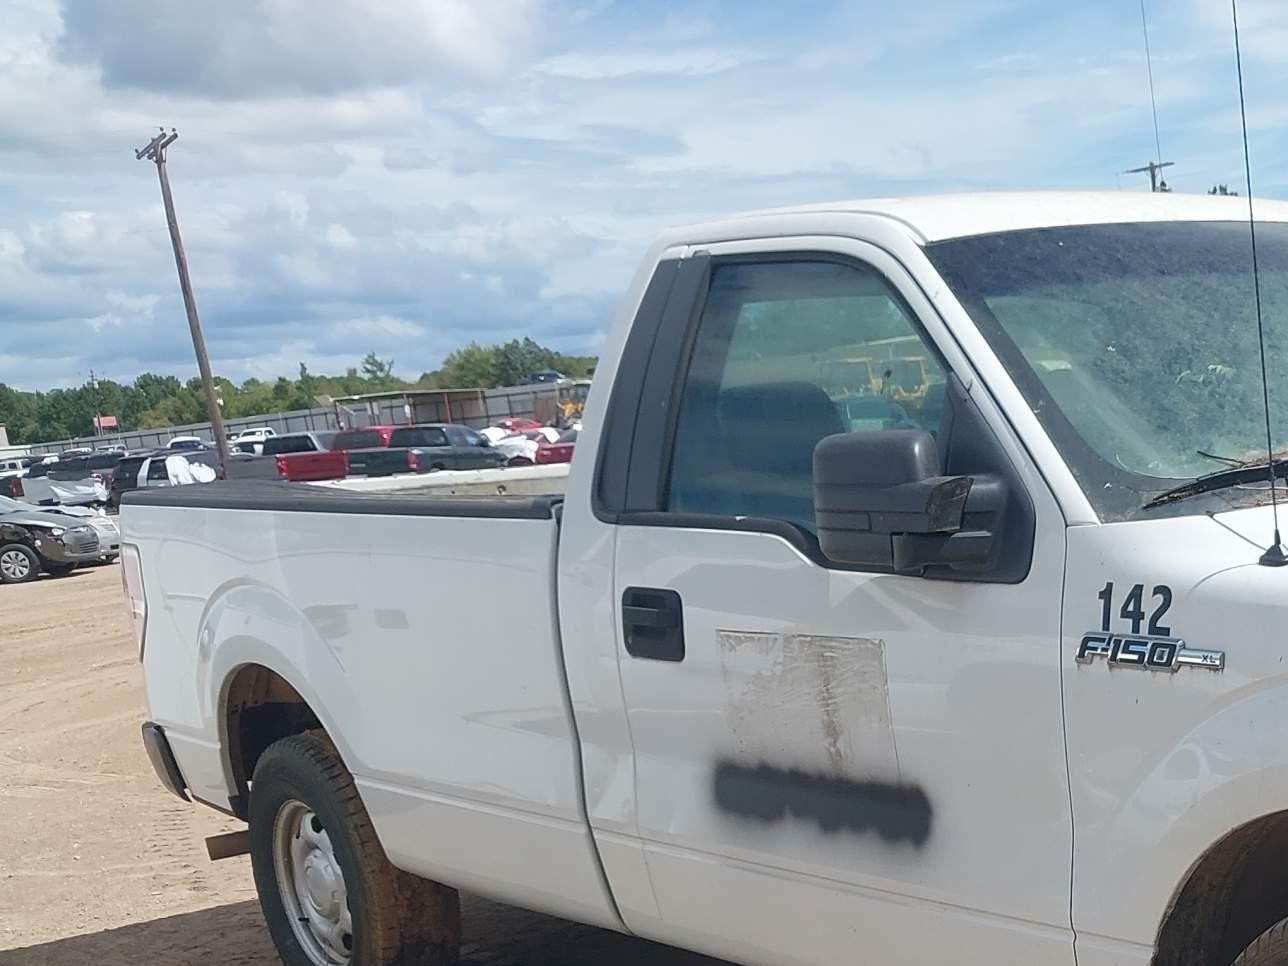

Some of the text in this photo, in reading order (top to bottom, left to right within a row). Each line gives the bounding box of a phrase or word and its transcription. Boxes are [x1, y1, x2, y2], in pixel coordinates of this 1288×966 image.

[1098, 581, 1173, 637] 142
[1076, 634, 1217, 669] F-150 XL
